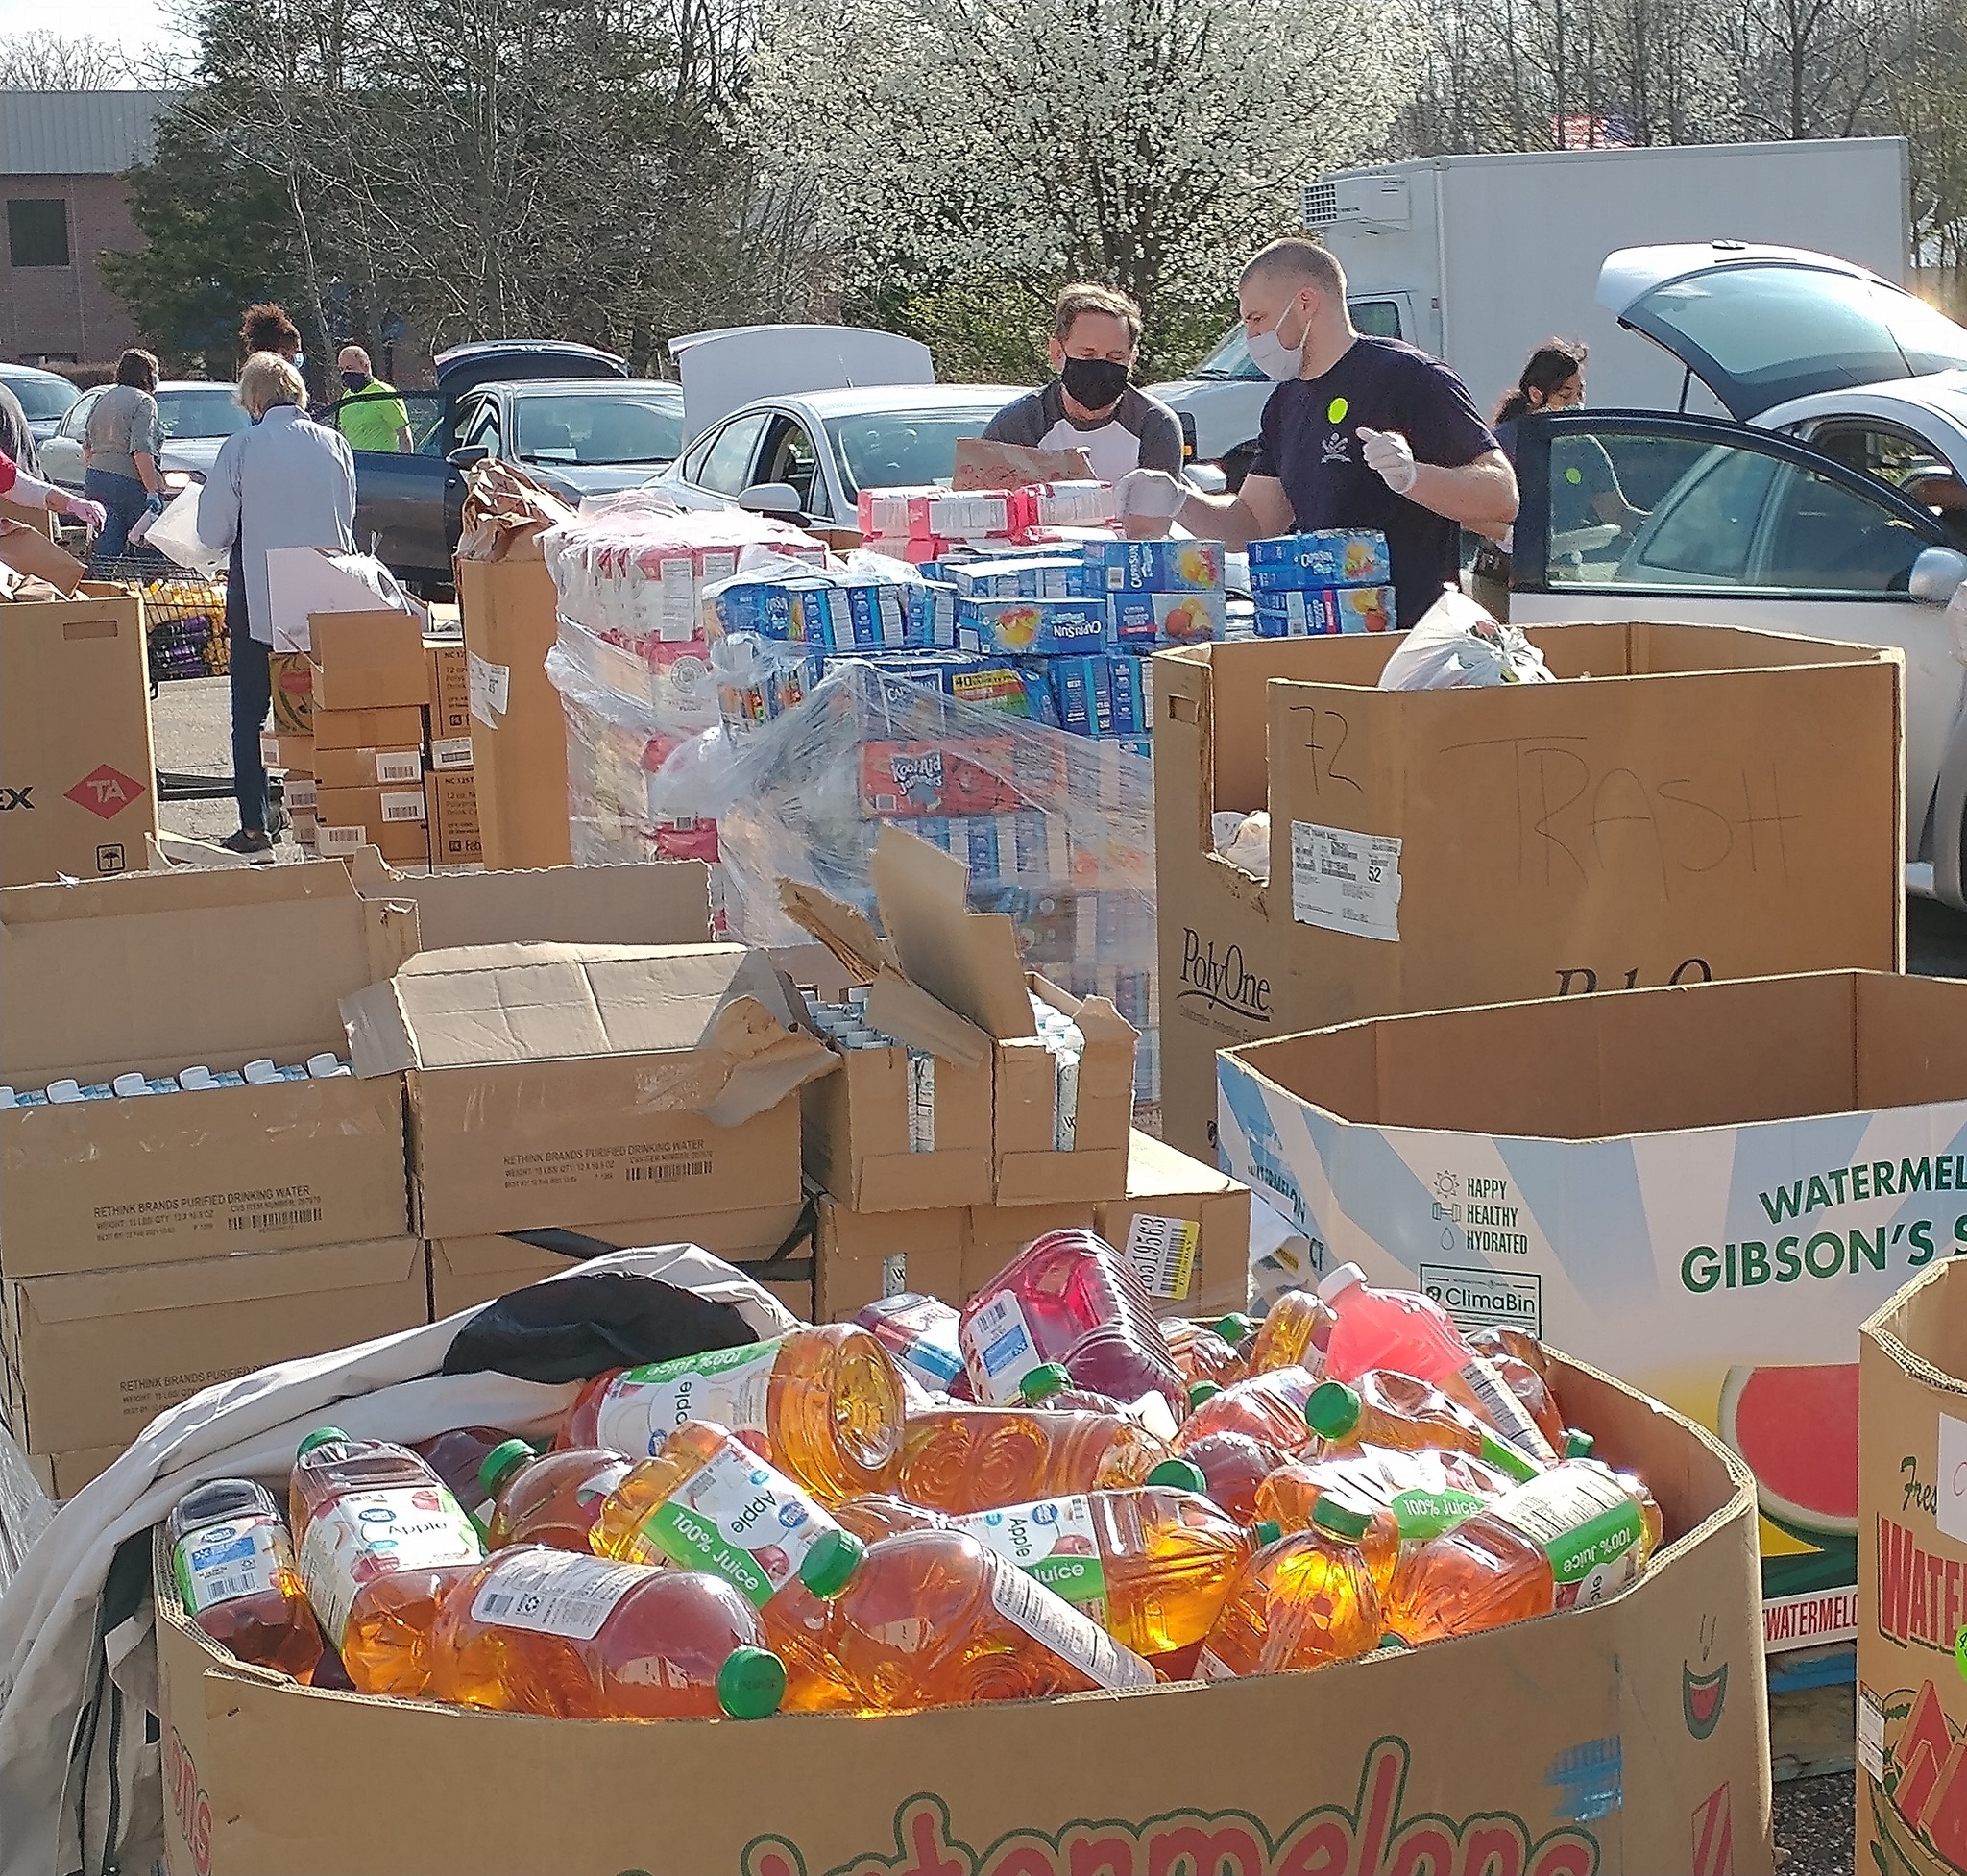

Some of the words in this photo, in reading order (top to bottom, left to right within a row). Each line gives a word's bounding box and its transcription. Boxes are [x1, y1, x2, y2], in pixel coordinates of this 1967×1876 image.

[1289, 706, 1363, 795] 72
[0, 786, 36, 810] X
[86, 779, 128, 804] TA
[1441, 736, 1803, 901] TRASH
[1368, 865, 1381, 883] 52
[1180, 927, 1271, 1010] PolyOne
[503, 1152, 544, 1166] RETHINK
[546, 1149, 583, 1163] BRANDS
[627, 1141, 671, 1156] DRINKING
[672, 1138, 705, 1151] WATER
[94, 1205, 136, 1218] RETHINK
[138, 1199, 180, 1214] BRANDS
[181, 1193, 227, 1208] PURIFIED
[227, 1188, 274, 1204] DRINKING
[276, 1184, 310, 1199] WATER
[1467, 1178, 1507, 1200] HAPPY
[1467, 1204, 1518, 1228] HEALTHY
[1131, 1217, 1167, 1291] 8519563
[1467, 1230, 1528, 1255] HYDRATED
[1445, 1287, 1536, 1314] ClimaBin
[647, 1358, 696, 1376] Juice
[699, 1352, 742, 1369] 100%
[120, 1377, 162, 1393] RETHINK
[164, 1371, 205, 1387] BRANDS
[674, 1381, 692, 1425] pple
[731, 1489, 778, 1534] Apple
[1403, 1498, 1440, 1518] 100%
[1442, 1498, 1479, 1516] Juice
[388, 1521, 448, 1536] Apple
[1008, 1518, 1032, 1558] Apple
[1599, 1527, 1631, 1555] 100%
[672, 1511, 714, 1554] 100%
[712, 1549, 760, 1591] Juice
[1563, 1545, 1597, 1573] Juice
[1879, 1516, 1967, 1648] WATE
